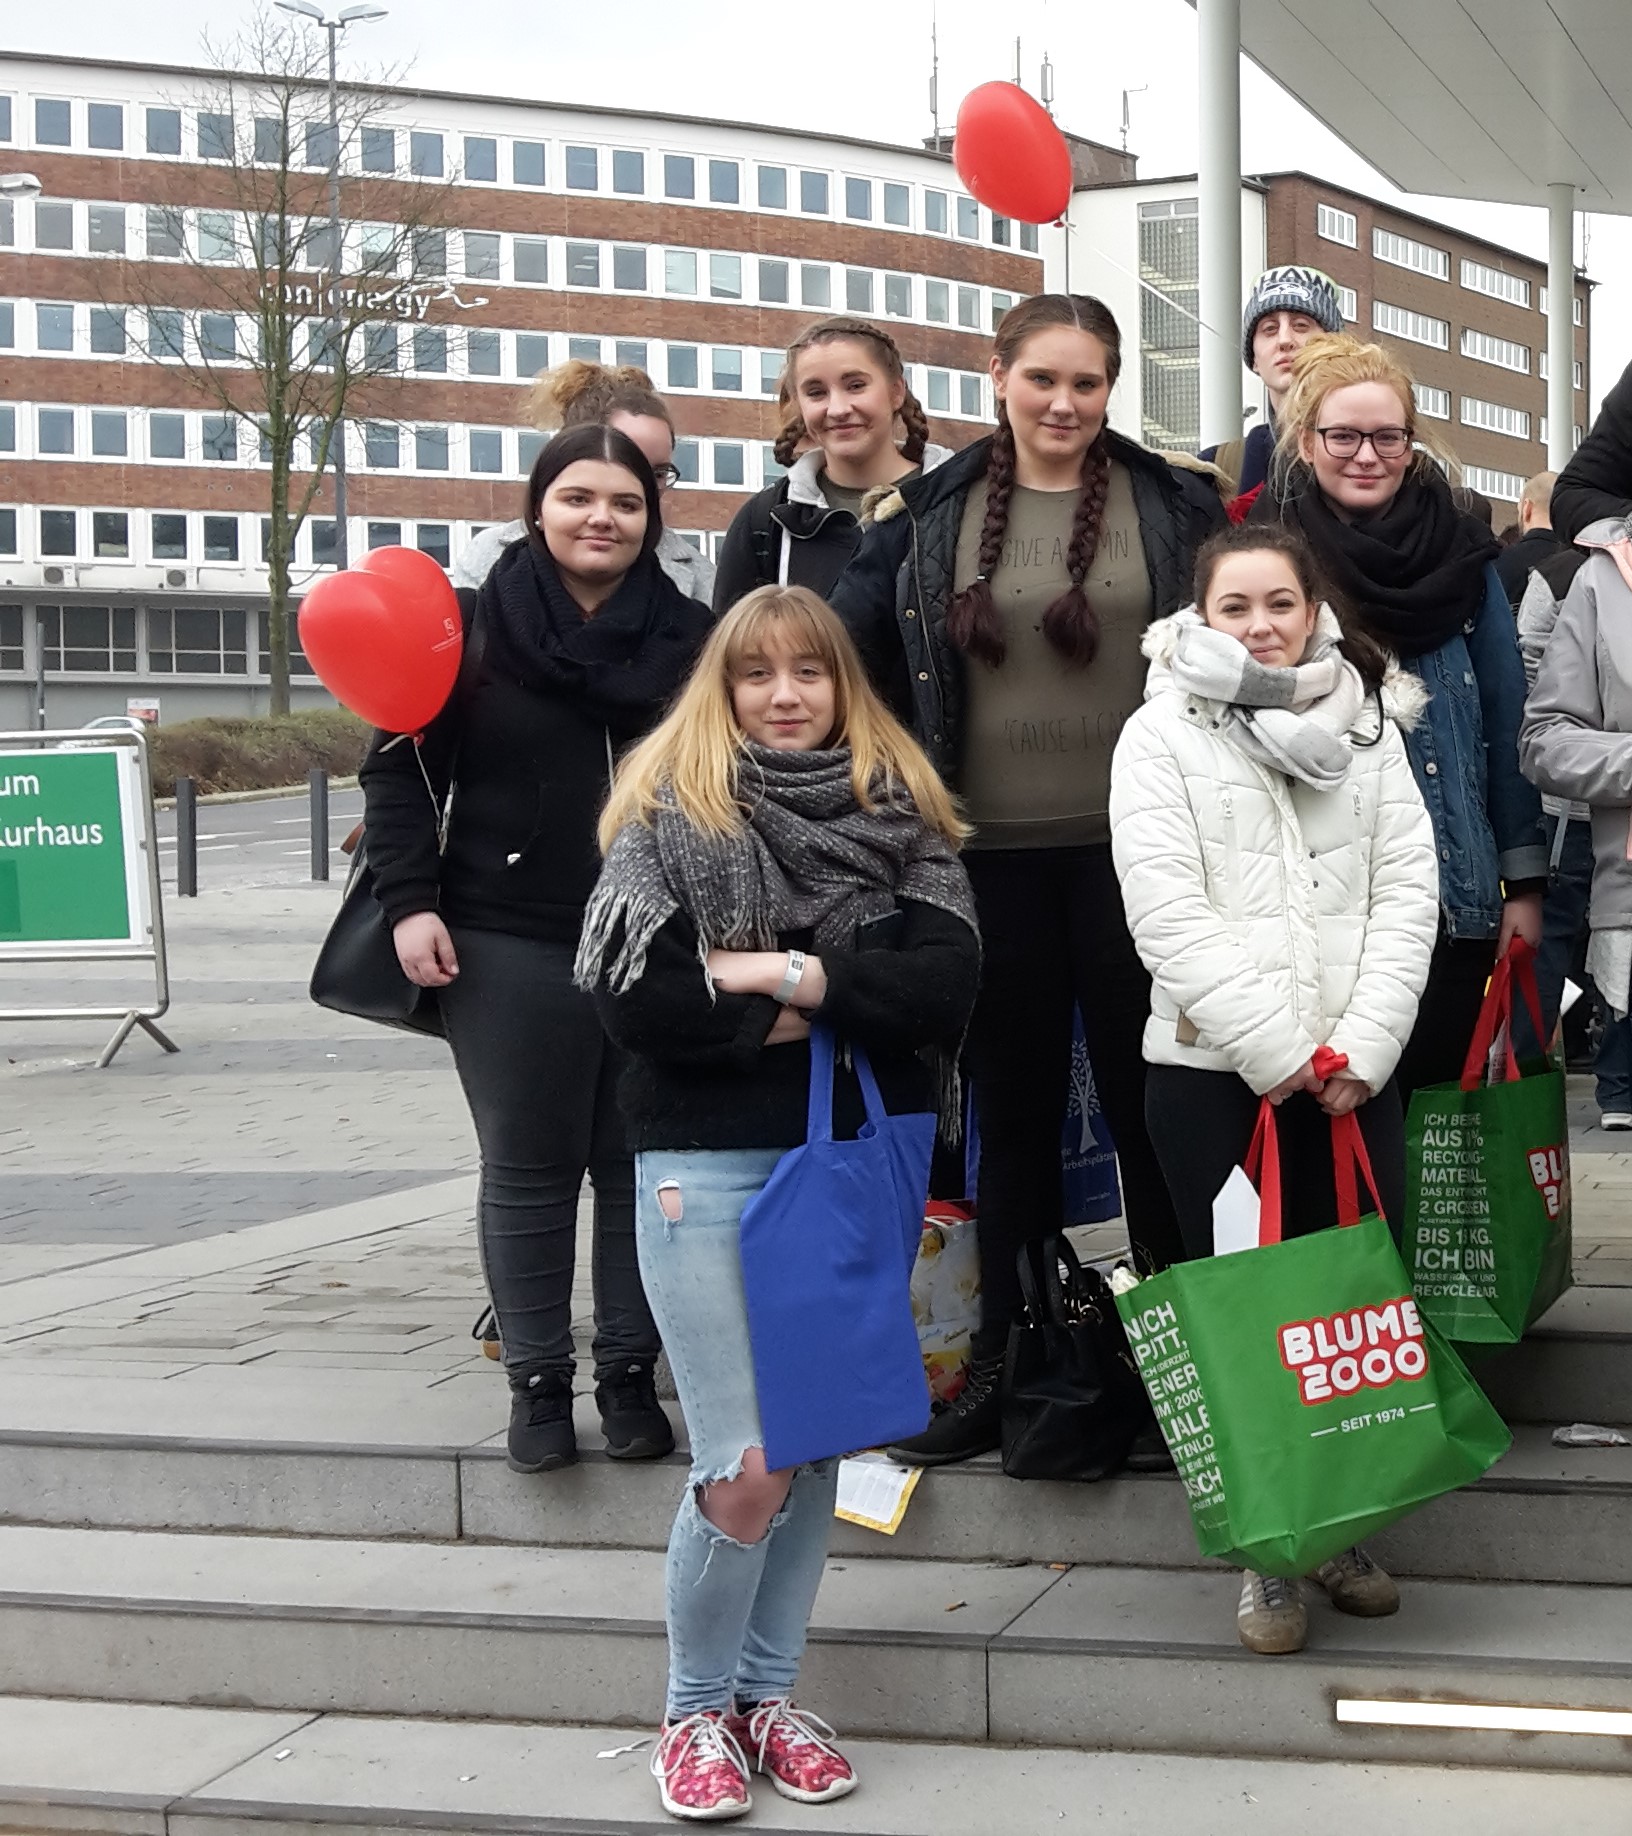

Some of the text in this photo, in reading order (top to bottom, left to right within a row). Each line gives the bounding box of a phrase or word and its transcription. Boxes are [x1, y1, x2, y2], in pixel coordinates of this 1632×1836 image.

[1000, 536, 1045, 568] GIVE
[1051, 536, 1063, 565] A
[0, 816, 104, 848] urhaus
[1423, 1113, 1447, 1126] ICH
[1422, 1129, 1463, 1148] AUS
[1420, 1187, 1442, 1197] DAS
[1418, 1200, 1430, 1214] 2
[1416, 1227, 1451, 1245] BIS
[1414, 1247, 1495, 1271] ICH BIN
[1282, 1300, 1424, 1366] BLUME
[1301, 1340, 1426, 1401] 2000
[1340, 1406, 1406, 1433] SEIT 1974
